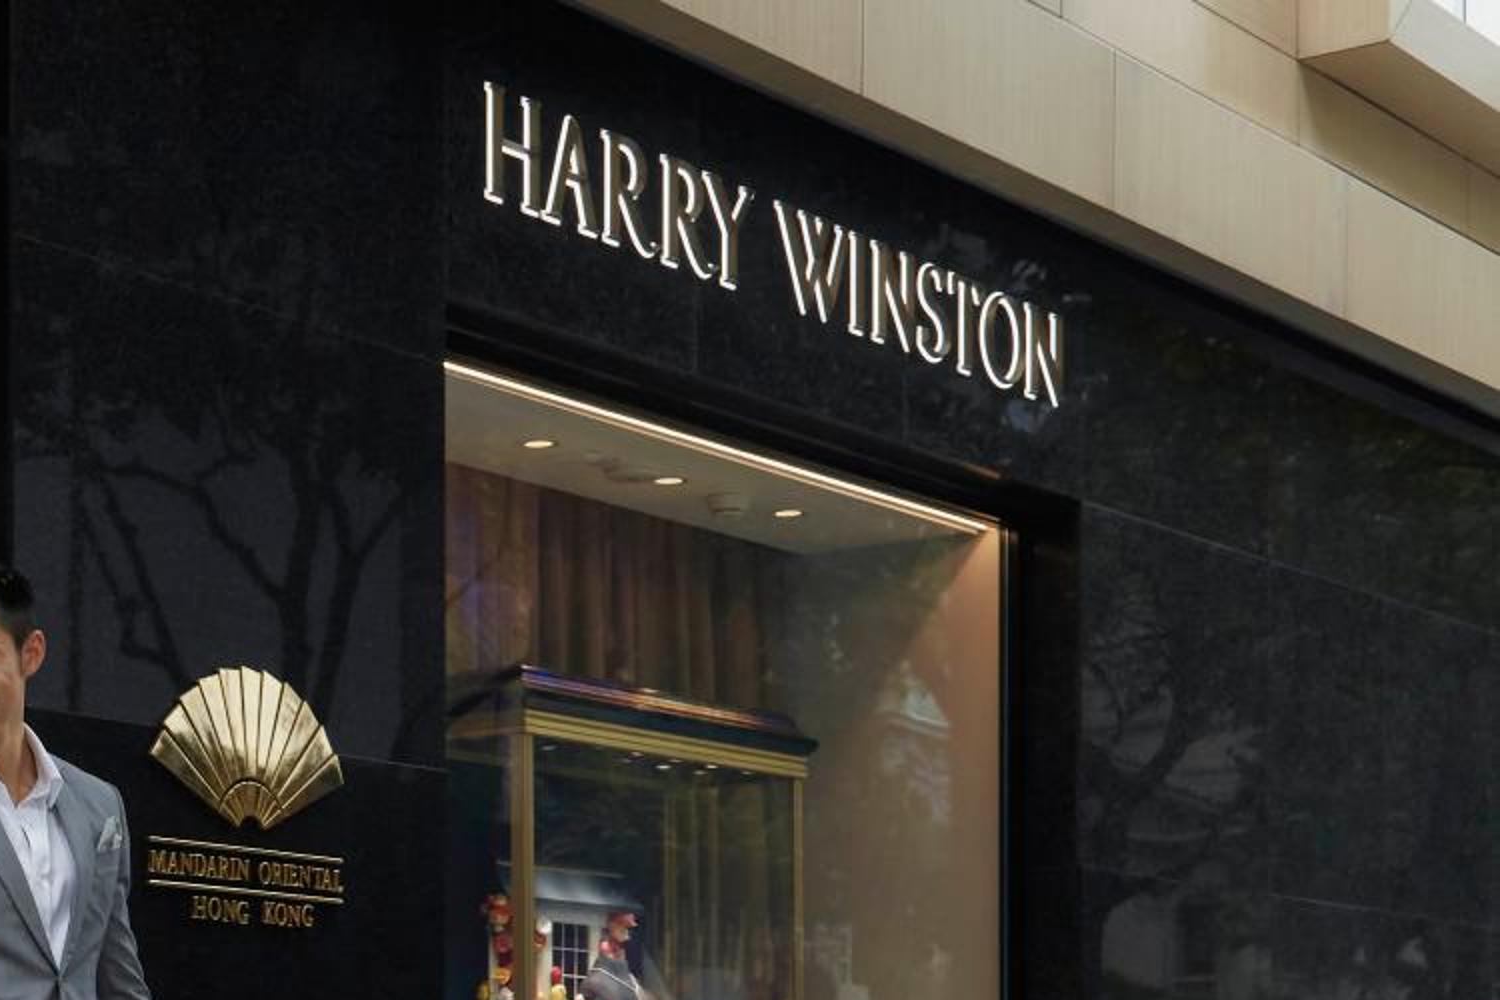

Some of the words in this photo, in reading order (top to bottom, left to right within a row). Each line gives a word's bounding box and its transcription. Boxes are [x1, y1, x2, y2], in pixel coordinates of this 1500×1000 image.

[483, 81, 753, 291] HARRY
[773, 199, 1061, 408] WINSTON
[149, 849, 249, 881] MANDARIN
[258, 861, 343, 893] ORIENTAL
[190, 895, 249, 925] HONG
[261, 902, 315, 927] KONG
